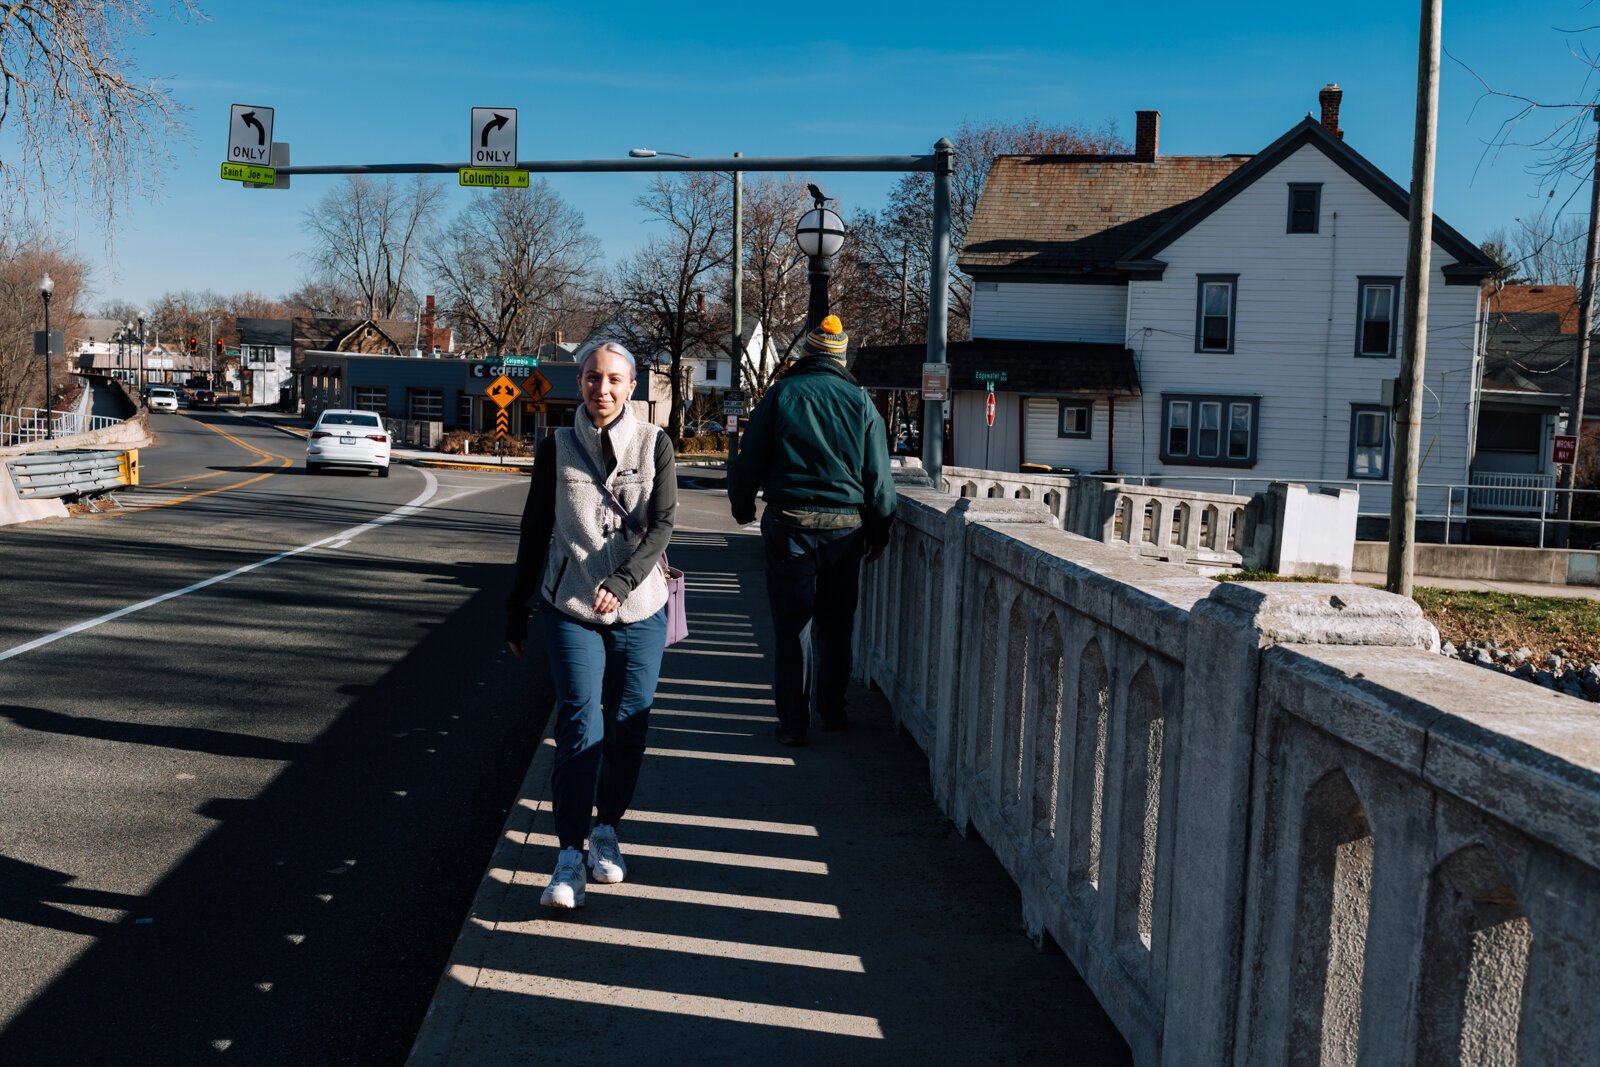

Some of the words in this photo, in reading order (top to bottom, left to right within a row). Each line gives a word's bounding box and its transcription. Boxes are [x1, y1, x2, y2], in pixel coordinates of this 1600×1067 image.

[234, 147, 265, 159] ONLY
[477, 151, 510, 162] ONLY
[224, 167, 242, 177] Saint
[247, 169, 261, 180] Joe
[463, 172, 509, 184] Columbia
[518, 175, 526, 183] Av
[506, 357, 528, 365] Columbia
[489, 366, 530, 377] COFFEE
[976, 371, 1000, 380] Edgewater
[1556, 440, 1574, 449] WRONG
[1558, 451, 1570, 459] WAY
